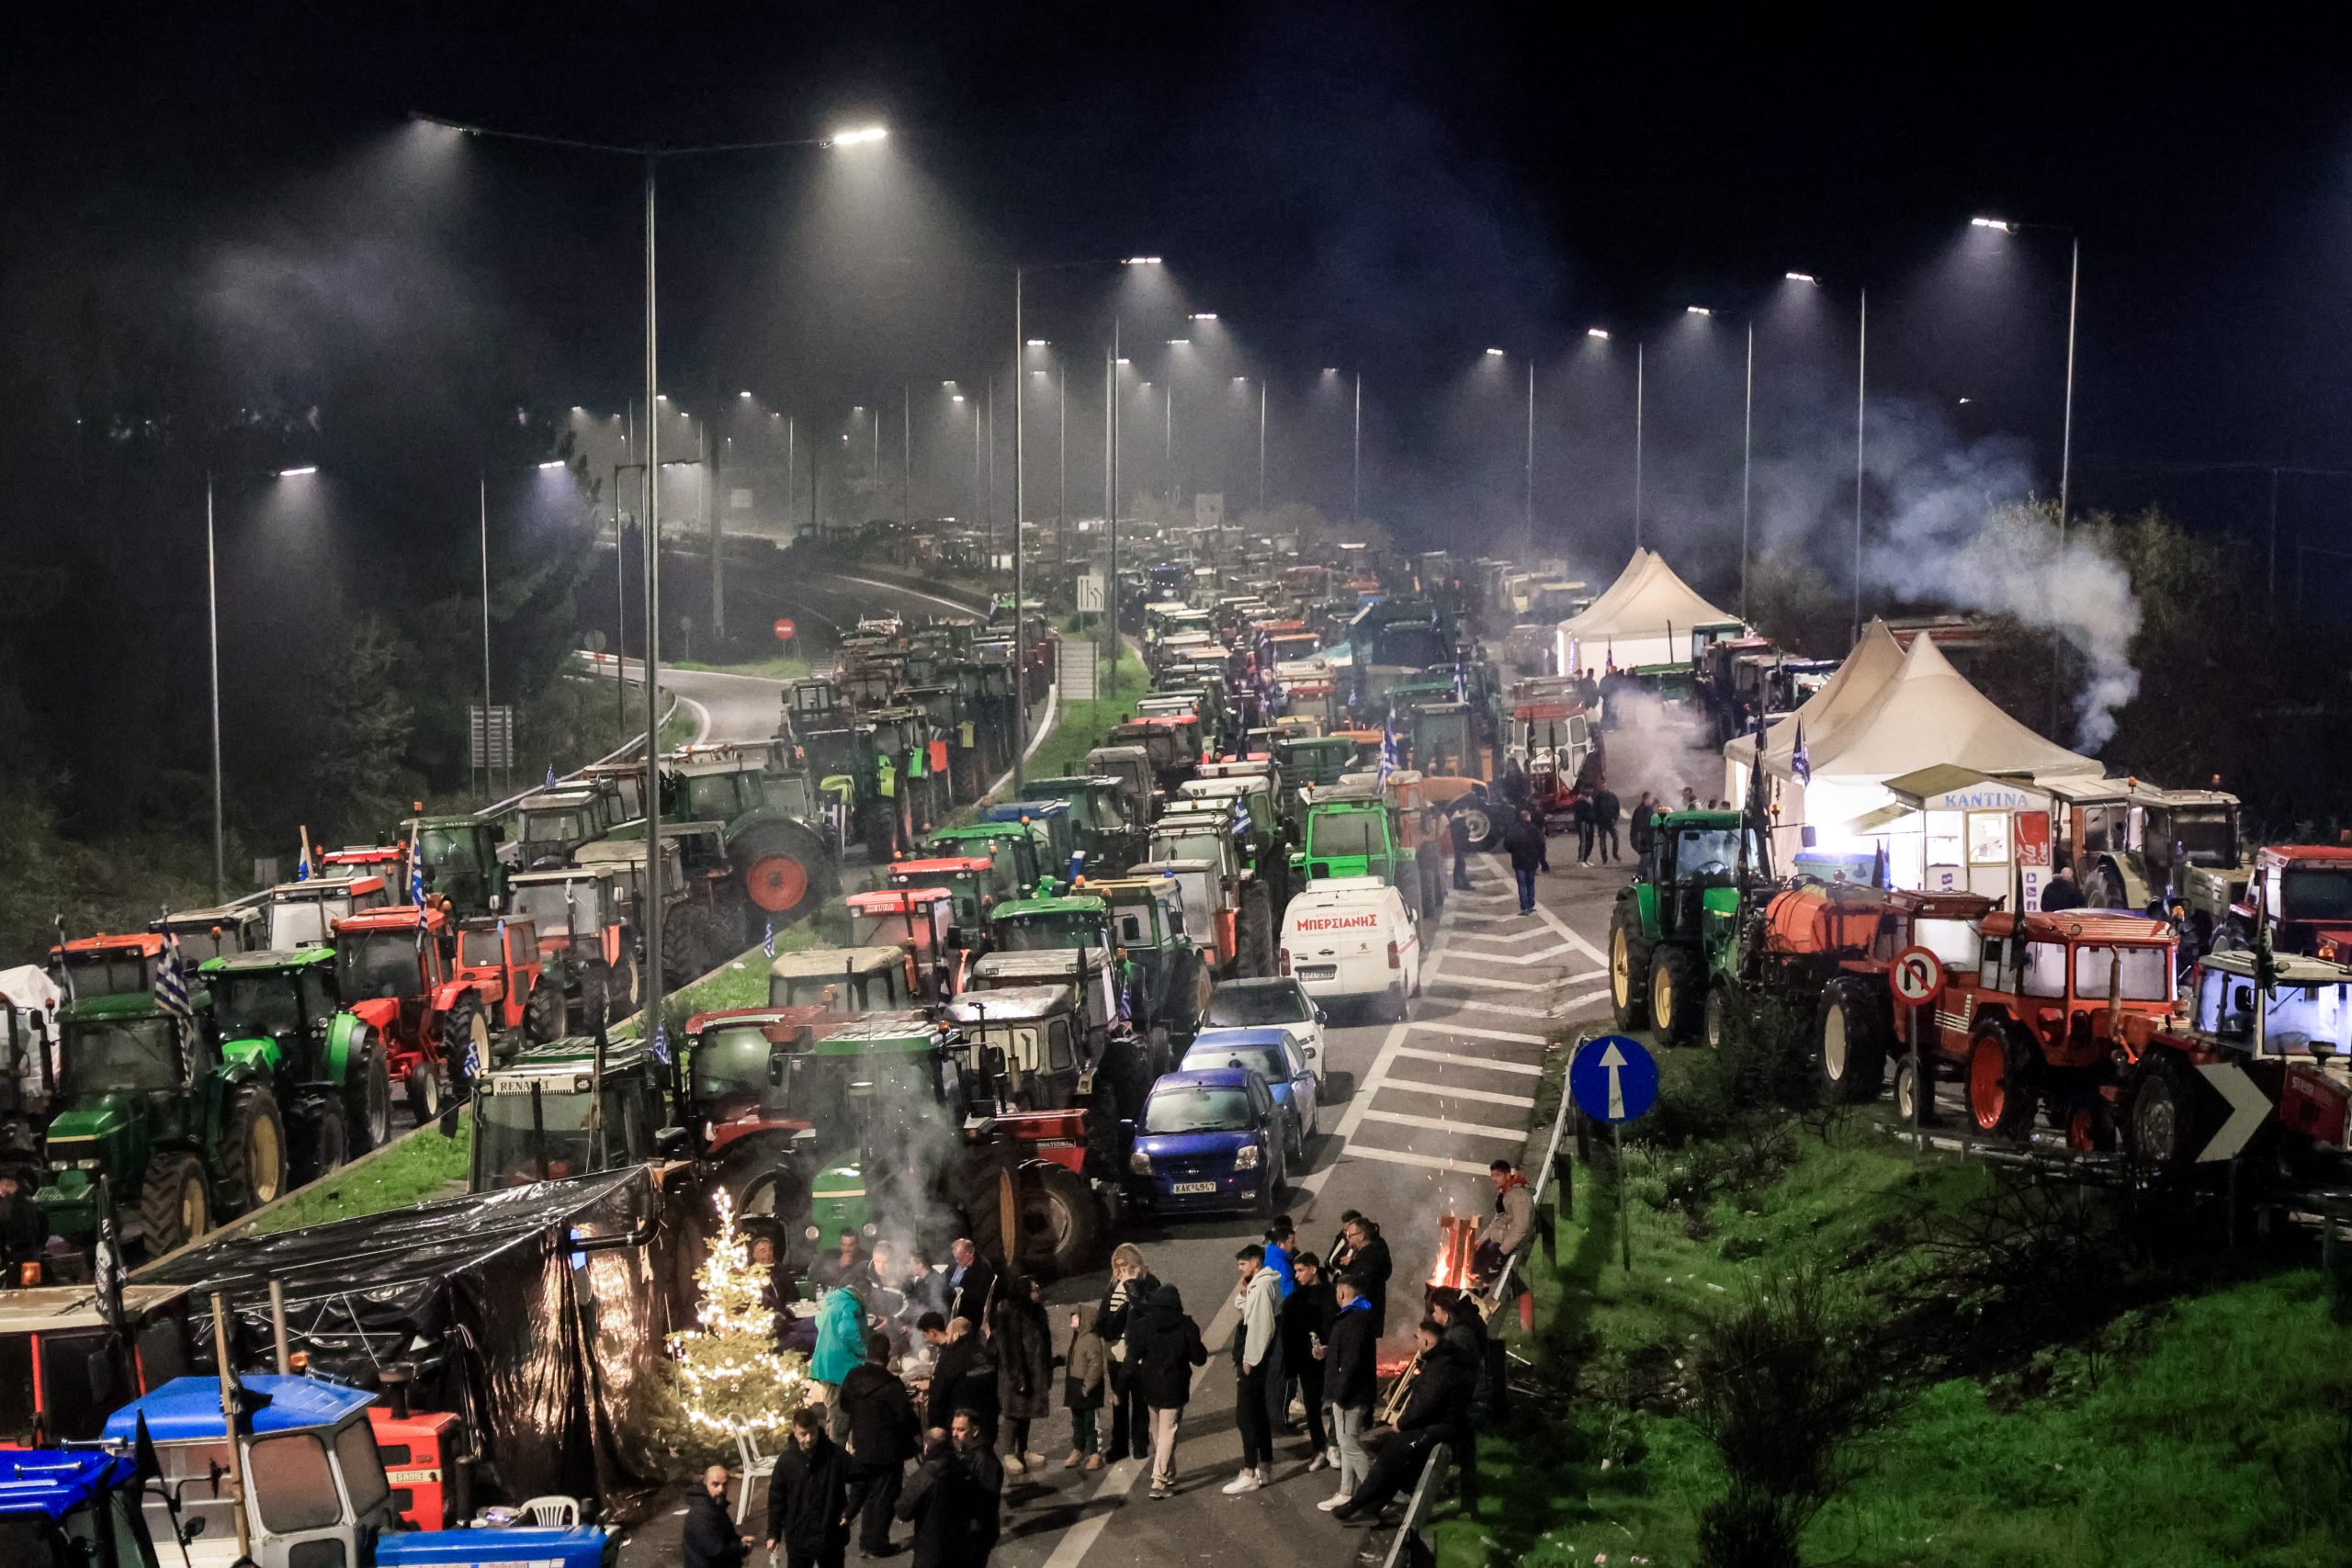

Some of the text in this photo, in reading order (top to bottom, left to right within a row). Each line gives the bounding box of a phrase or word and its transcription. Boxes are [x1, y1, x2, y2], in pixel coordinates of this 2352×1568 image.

[1945, 792, 2029, 807] KANTINA
[866, 903, 895, 912] ZETOR
[1297, 914, 1376, 931] ΜΠΕΡΣΙΑΝΗΣ
